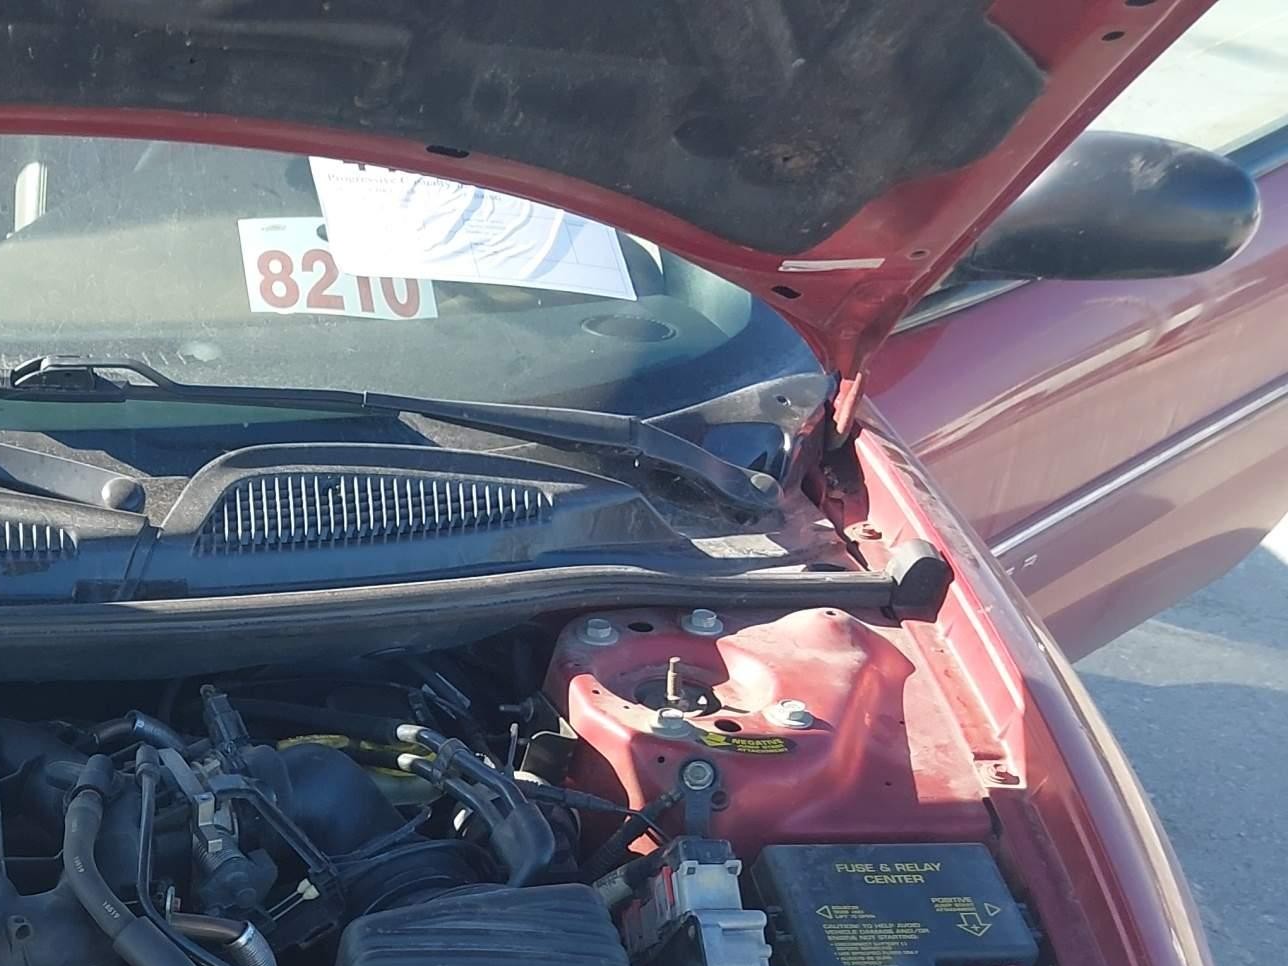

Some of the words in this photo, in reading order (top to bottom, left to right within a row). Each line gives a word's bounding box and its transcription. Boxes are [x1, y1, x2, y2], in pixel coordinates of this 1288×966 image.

[835, 863, 875, 872] FUSE
[880, 863, 891, 872] &
[896, 862, 942, 872] RELAY
[864, 874, 925, 884] CENTER
